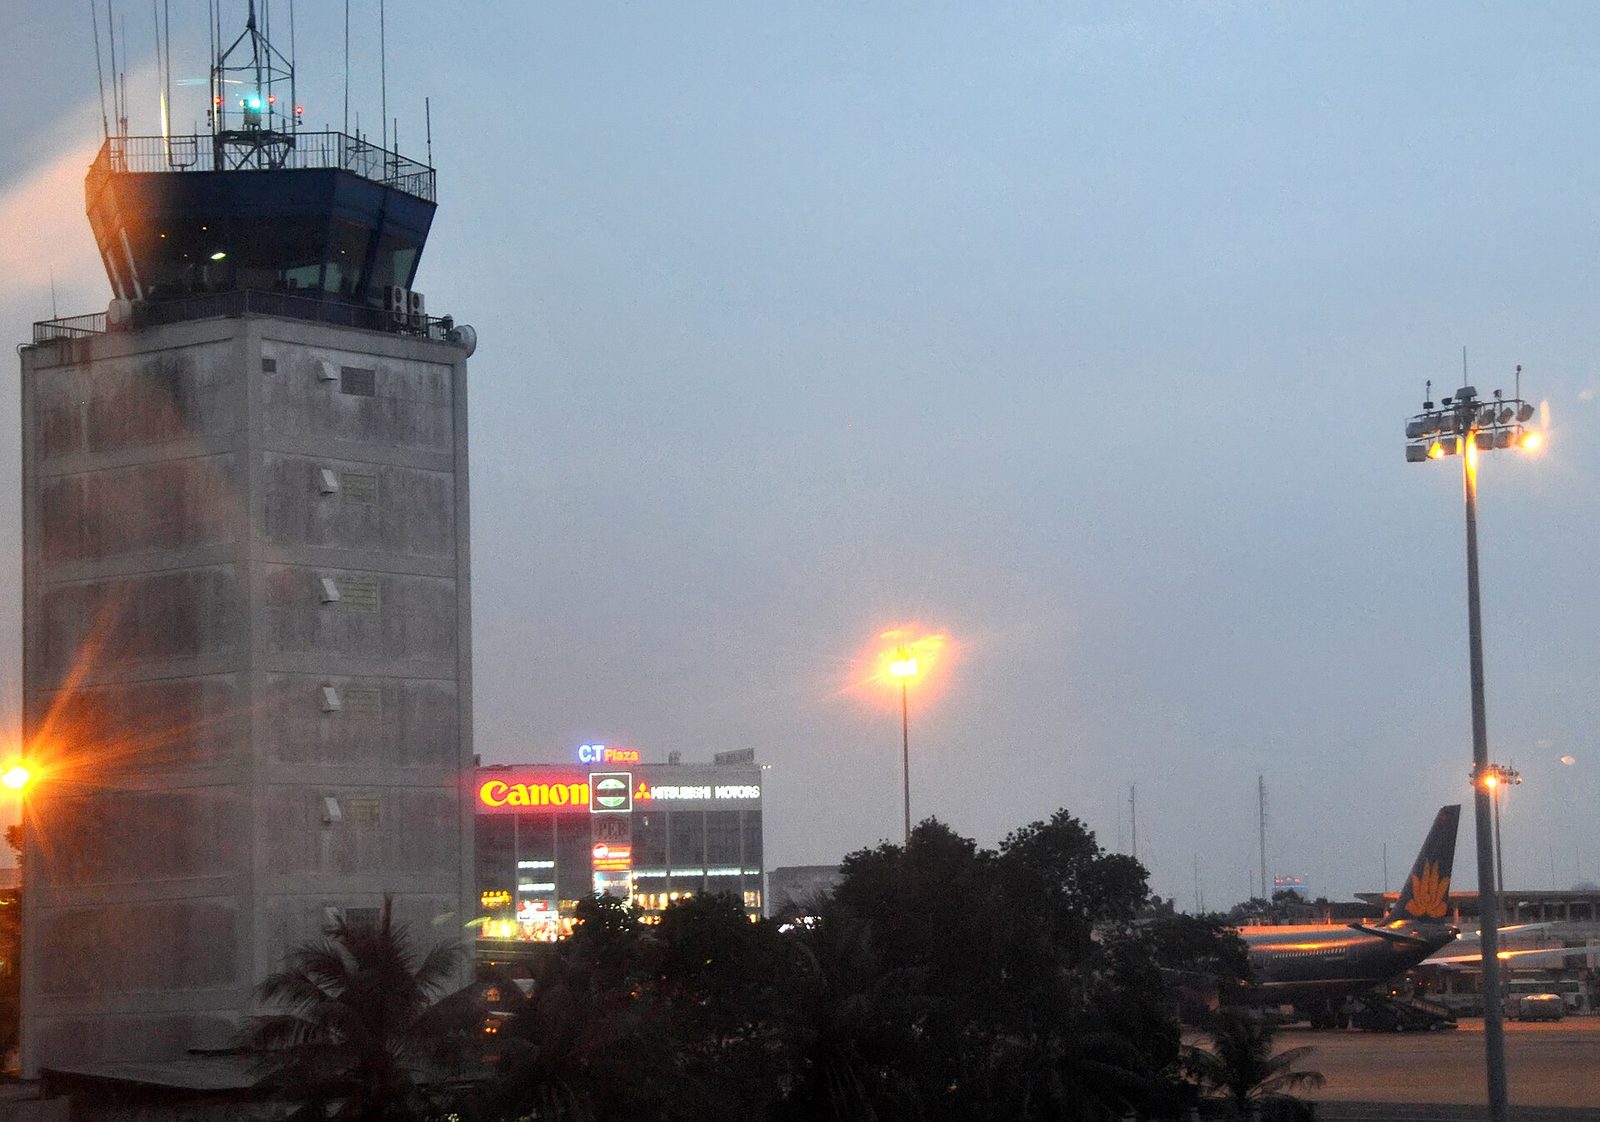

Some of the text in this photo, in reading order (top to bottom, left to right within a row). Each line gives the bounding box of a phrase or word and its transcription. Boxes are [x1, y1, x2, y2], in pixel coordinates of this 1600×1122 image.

[605, 749, 639, 762] Plaza
[480, 780, 589, 806] Canon
[651, 785, 760, 800] MITSUBISHI MOTORS
